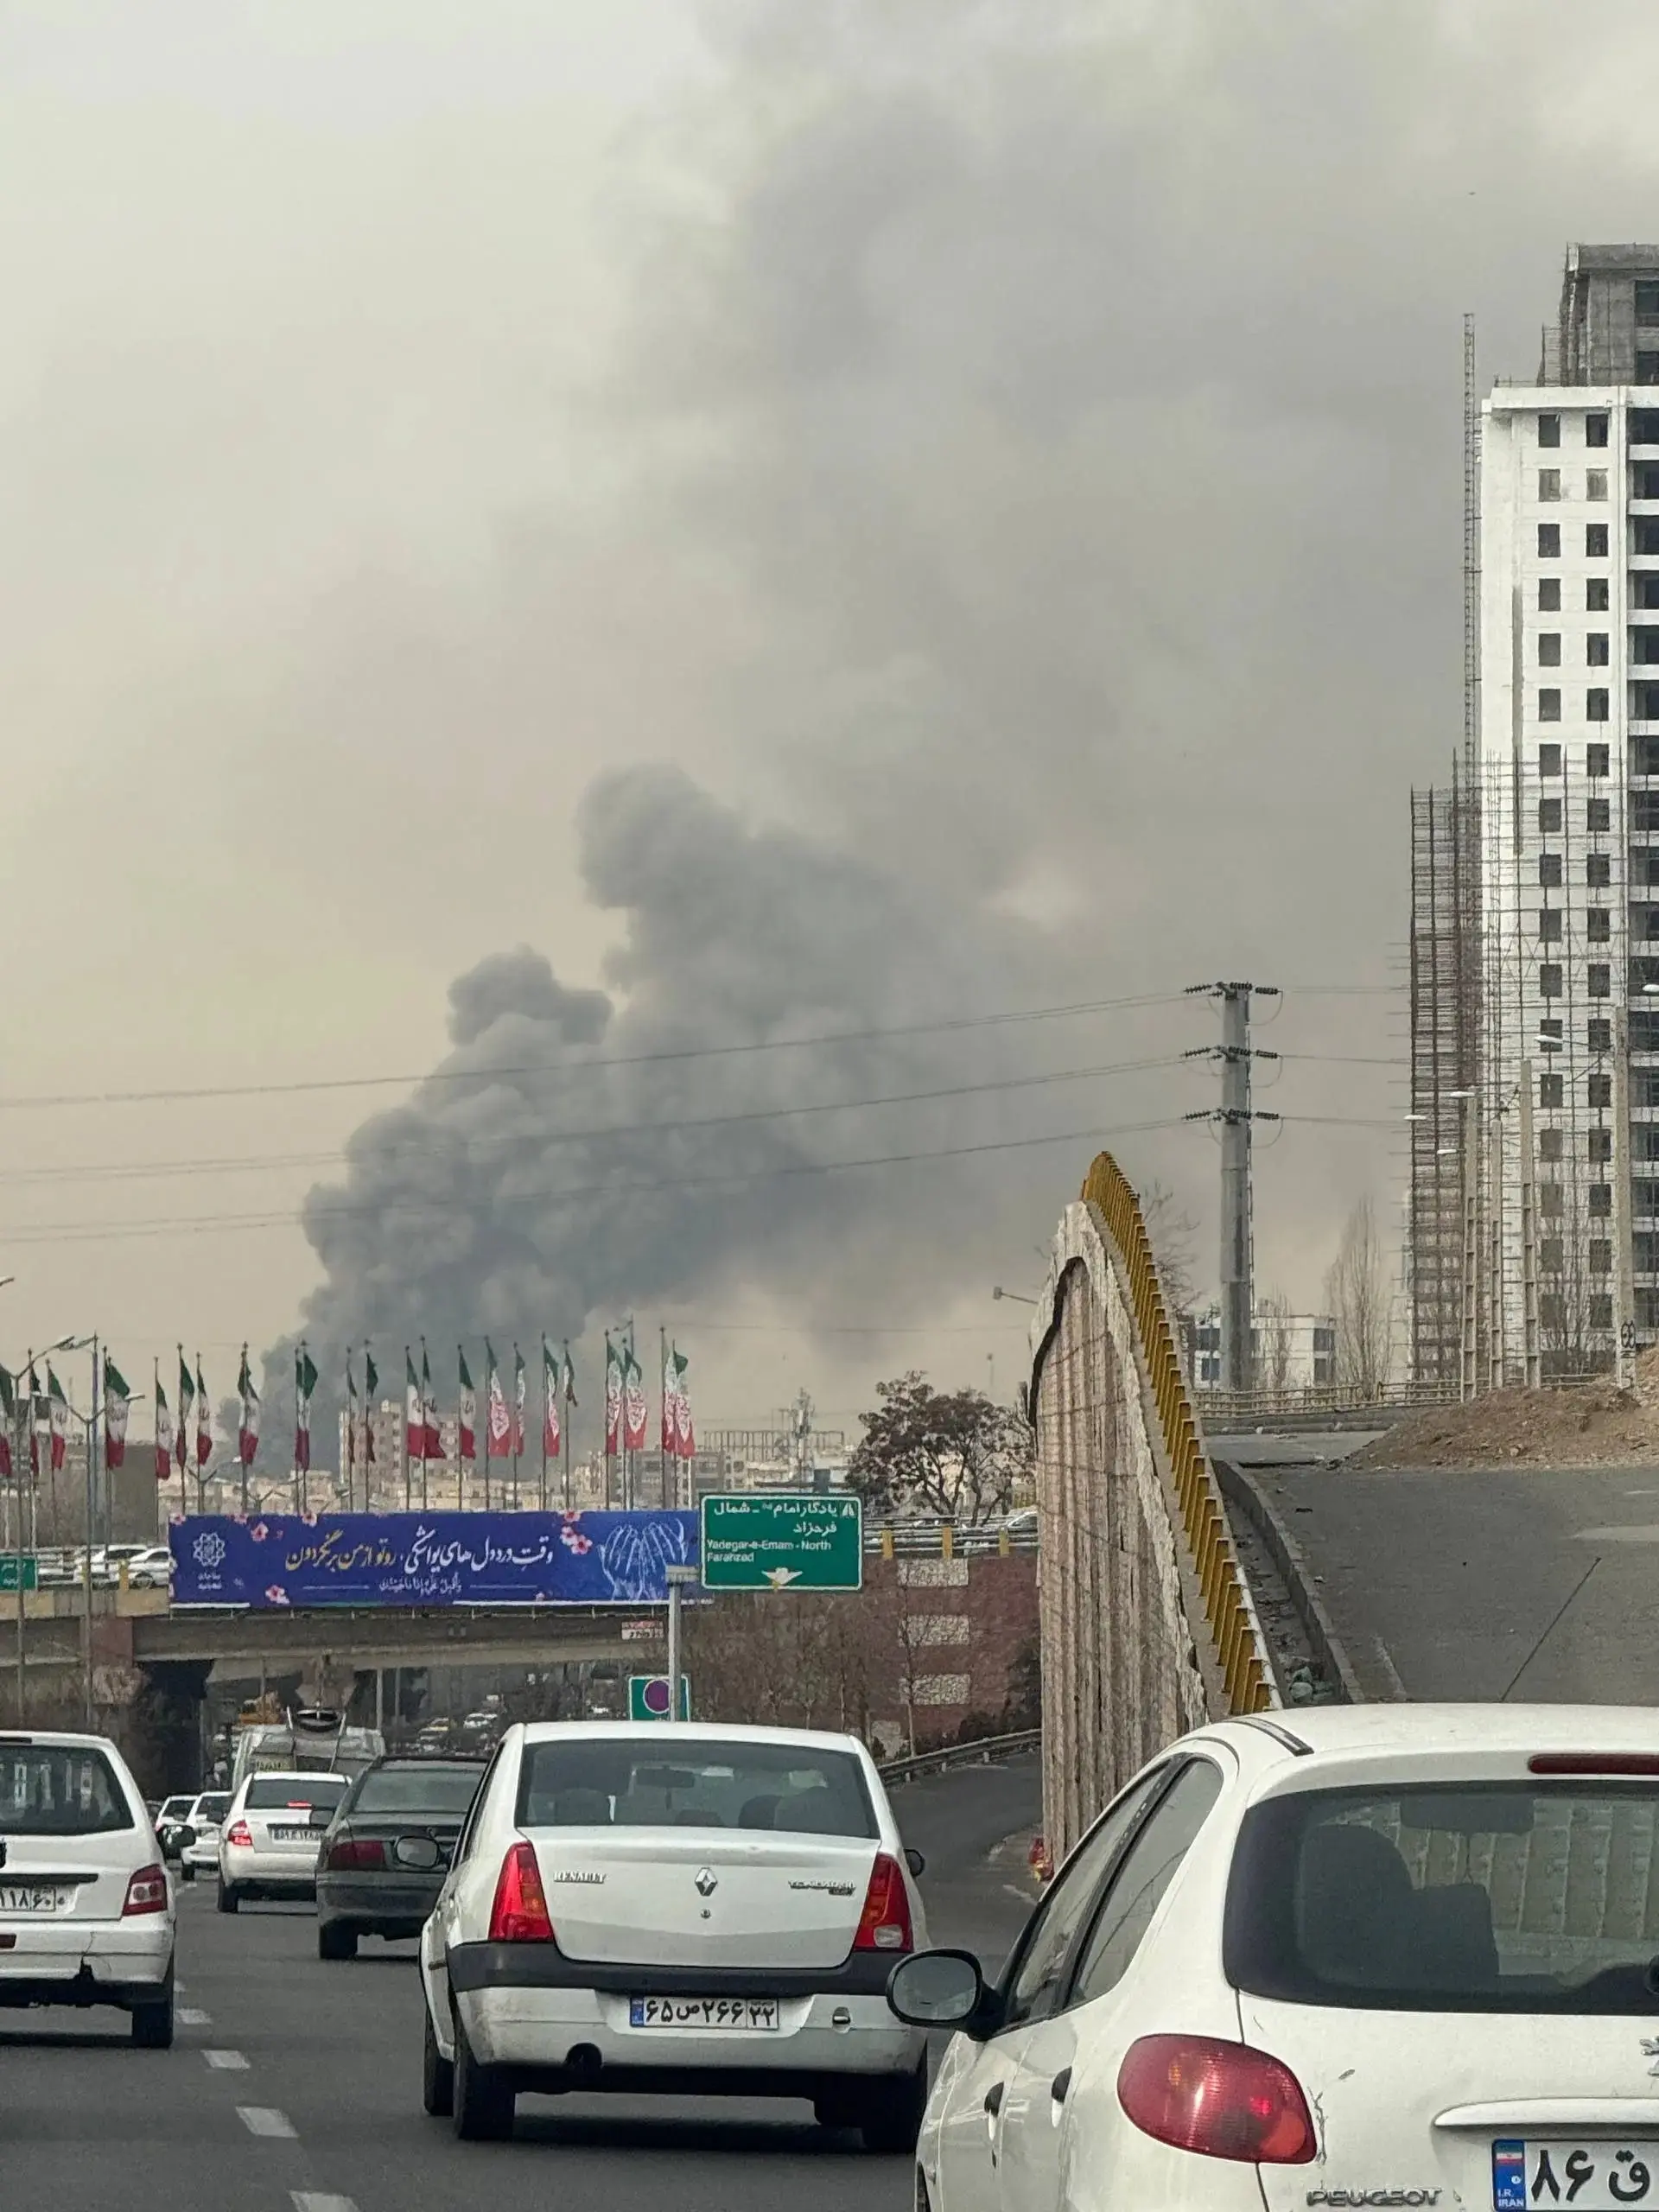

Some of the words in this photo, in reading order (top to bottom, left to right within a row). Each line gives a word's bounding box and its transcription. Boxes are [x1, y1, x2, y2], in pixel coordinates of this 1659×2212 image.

[714, 1501, 750, 1516] شمال
[773, 1502, 800, 1518] امام
[800, 1502, 837, 1517] یادگار
[793, 1521, 837, 1537] فرحزاد
[707, 1539, 793, 1552] Yadegar-e-Emam
[802, 1540, 831, 1550] North
[440, 1541, 471, 1566] های
[707, 1552, 753, 1562] Farahzad
[554, 1870, 606, 1885] RENAULT
[1306, 2188, 1443, 2207] PEUGEOT
[1497, 2198, 1524, 2208] IRAN
